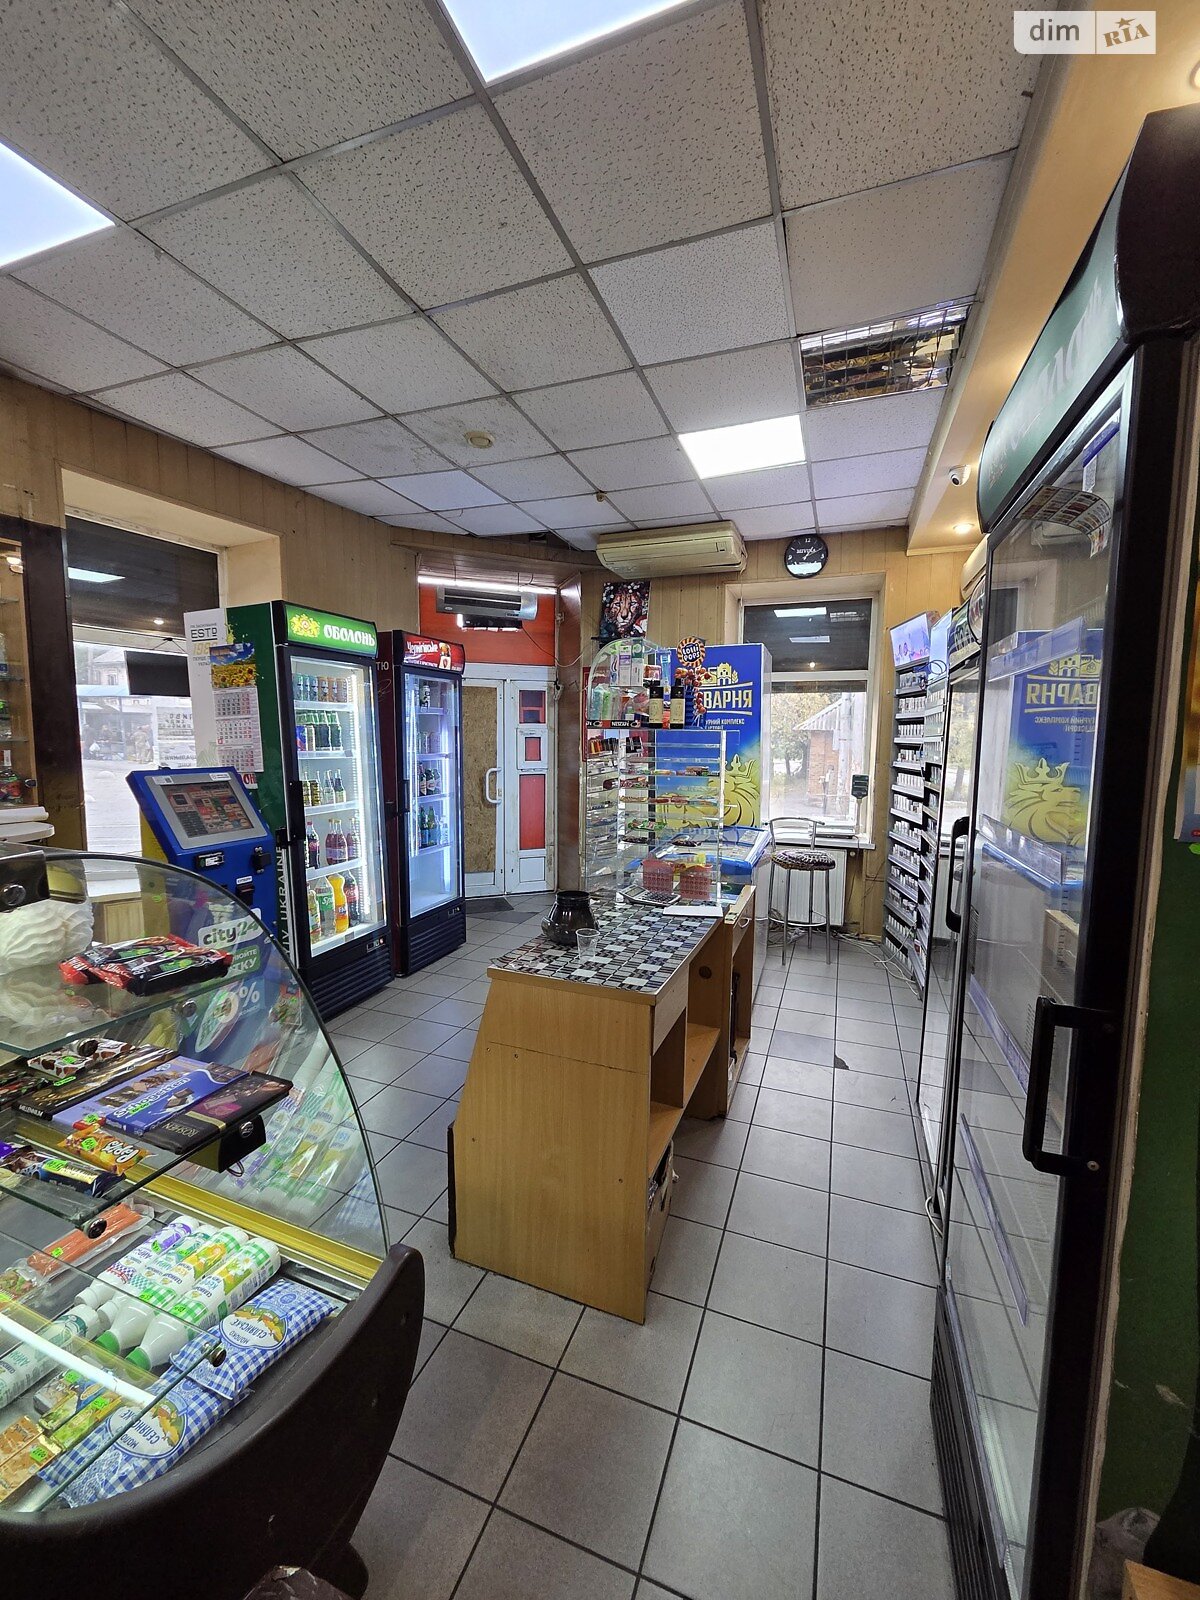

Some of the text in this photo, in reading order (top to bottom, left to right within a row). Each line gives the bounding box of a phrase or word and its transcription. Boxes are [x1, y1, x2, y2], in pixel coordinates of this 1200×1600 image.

[190, 627, 218, 639] ESTD
[323, 623, 376, 647] ОБОЛОНЬ
[376, 661, 389, 671] ТЮ
[703, 689, 752, 709] ВАРНЯ
[243, 772, 257, 785] ОН
[162, 1121, 200, 1138] ROSHEN
[228, 1331, 250, 1345] МОЛОКО
